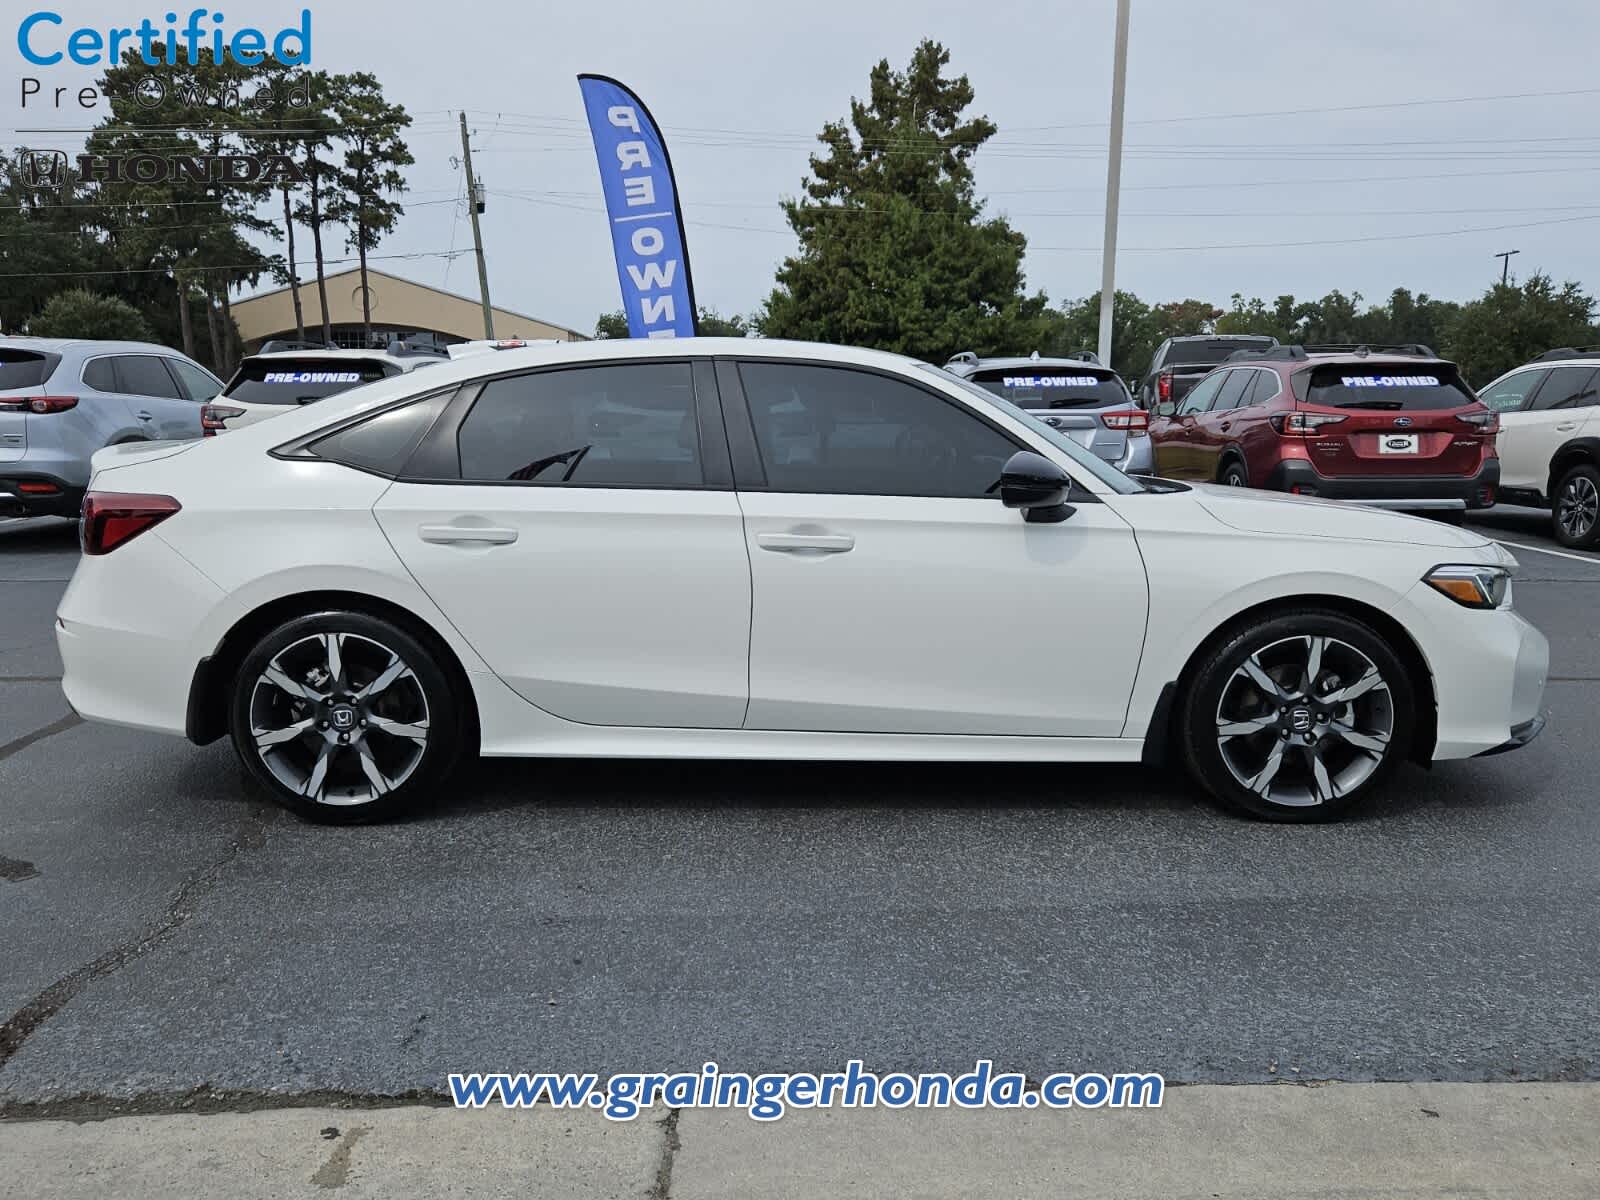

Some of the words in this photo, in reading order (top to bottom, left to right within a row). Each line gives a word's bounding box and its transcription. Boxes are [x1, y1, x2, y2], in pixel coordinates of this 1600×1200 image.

[264, 373, 360, 383] PRE-OWNED
[1003, 376, 1099, 387] PRE-OWNED
[1341, 376, 1439, 387] PRE-OWNED
